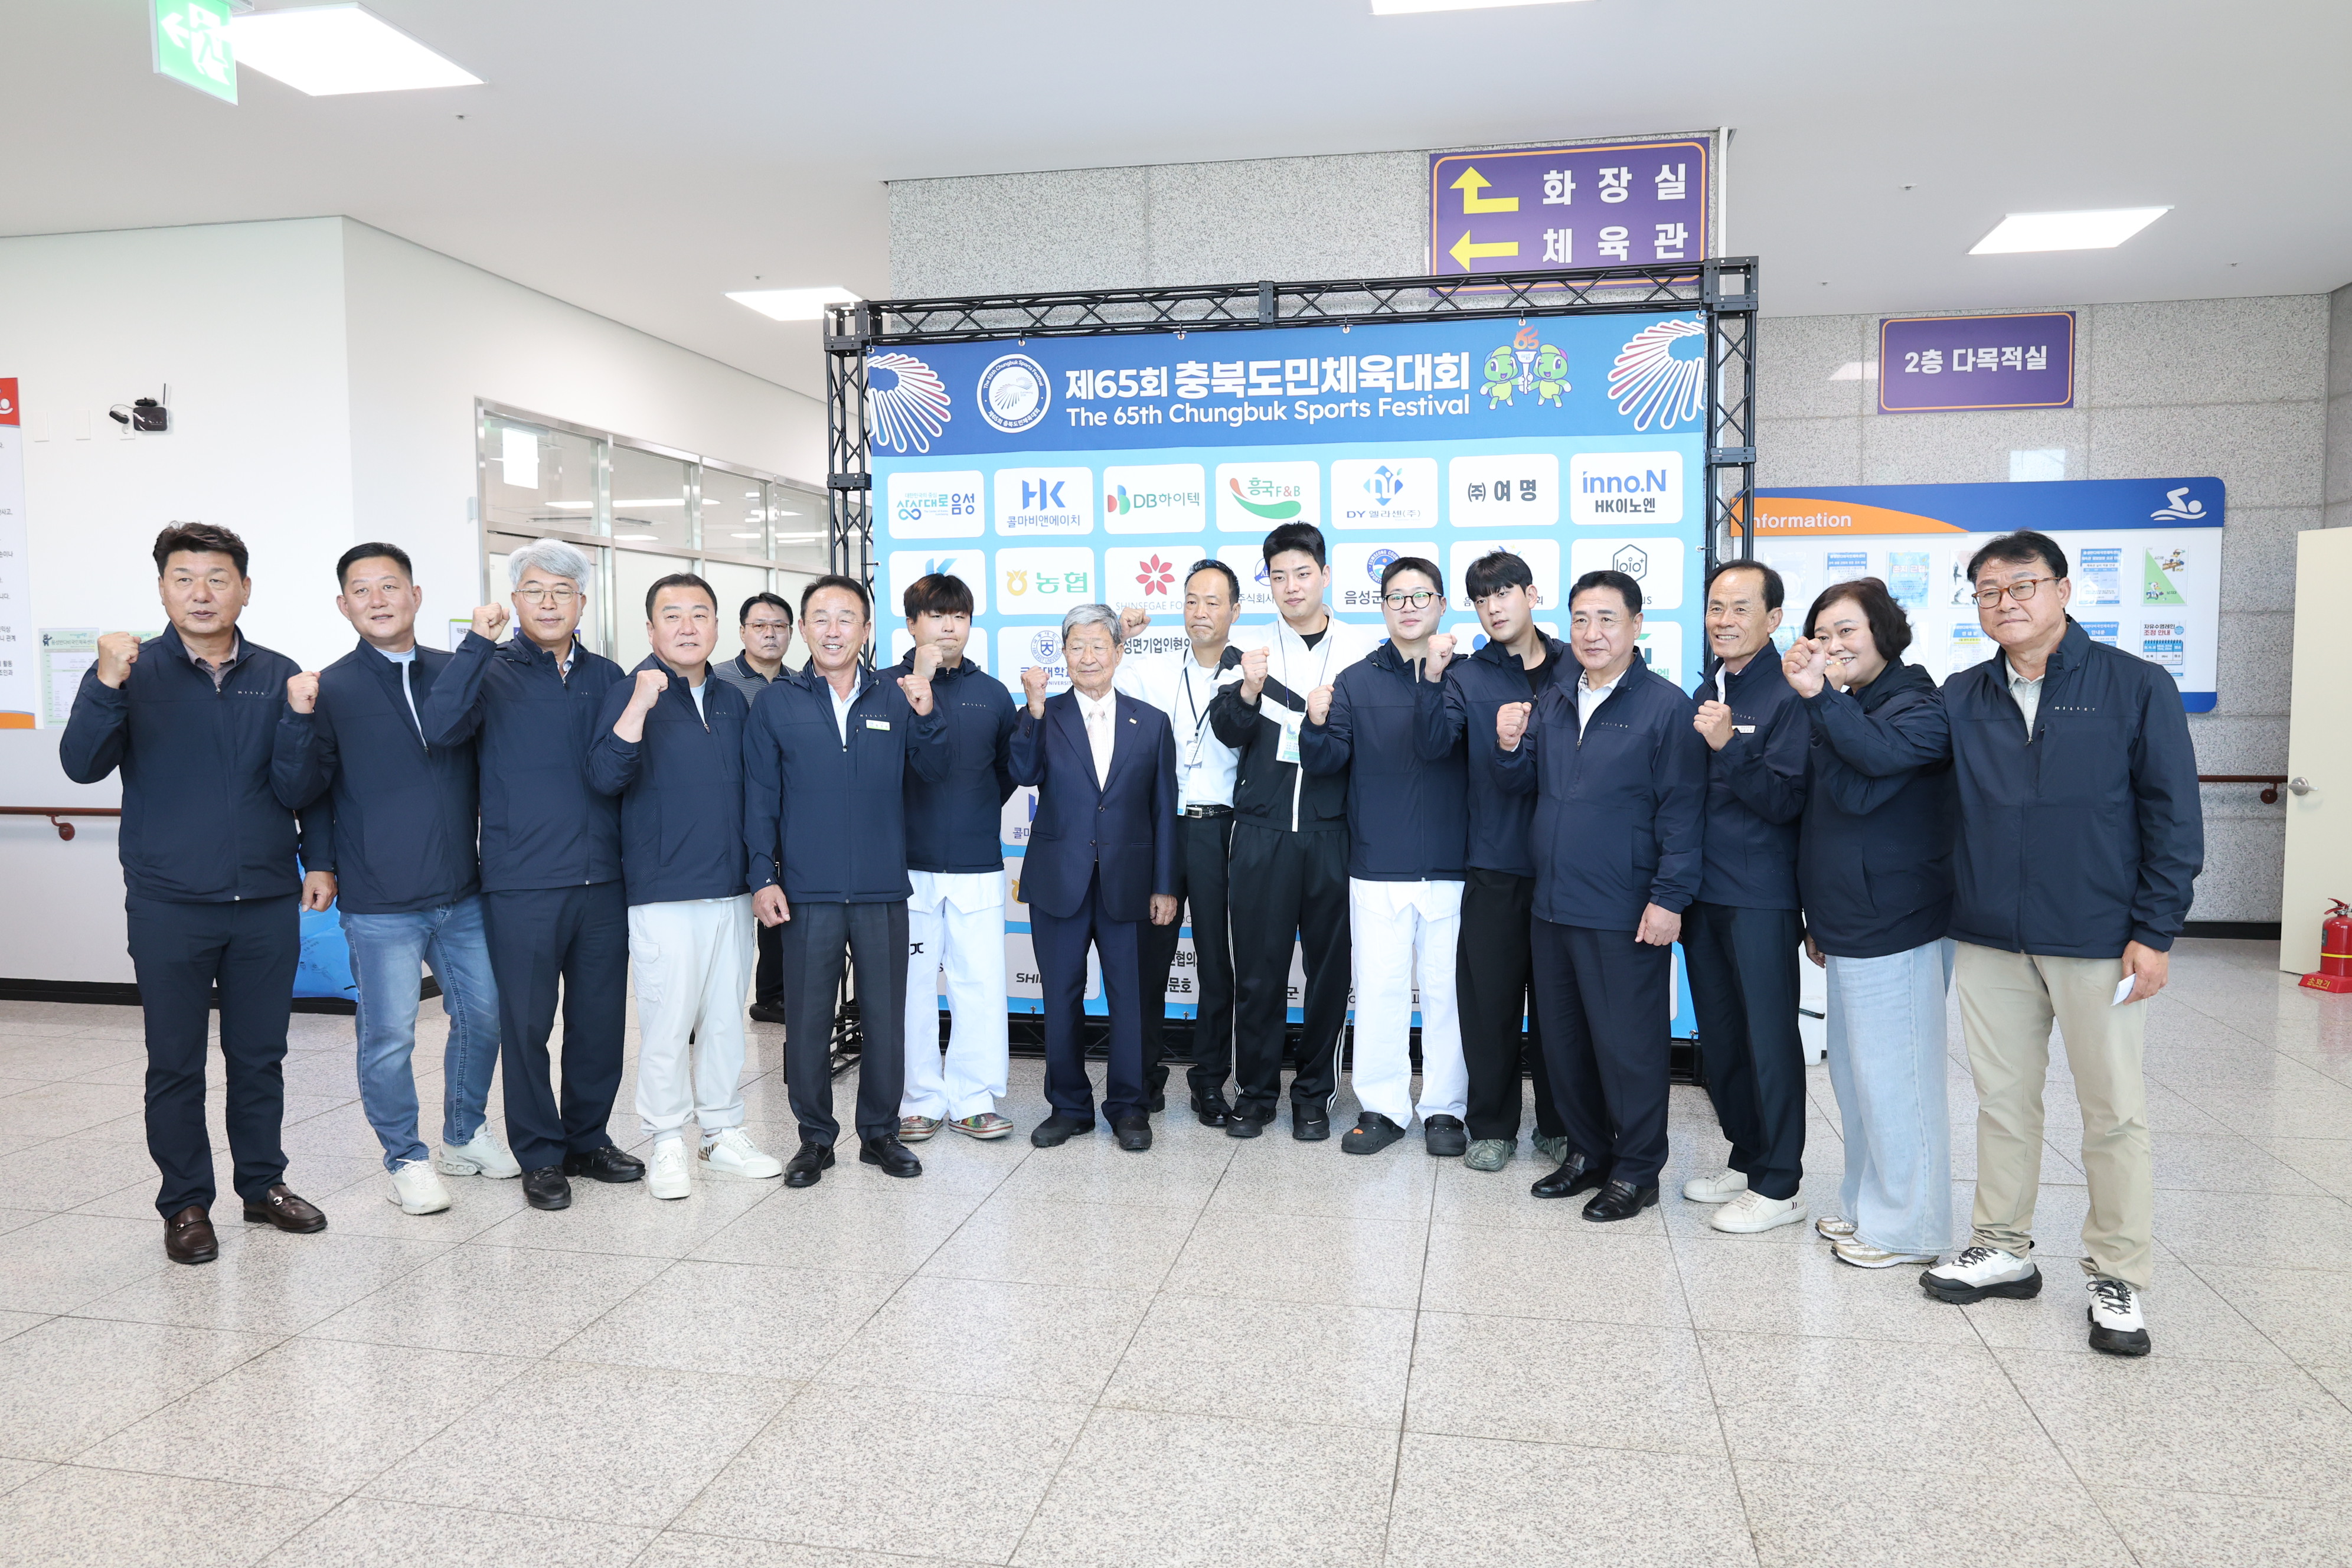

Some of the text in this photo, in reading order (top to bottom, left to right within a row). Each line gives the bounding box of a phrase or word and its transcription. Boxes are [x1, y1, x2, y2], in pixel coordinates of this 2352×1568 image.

[1904, 345, 2047, 374] 2층 다목적실
[995, 360, 1018, 371] Chungbuk
[1018, 360, 1033, 371] Sports
[1031, 368, 1044, 387] Festival
[1065, 351, 1470, 400] 제65회 충북도민체육대회
[1066, 393, 1469, 428] The 65th Chungbuk Sports Festival
[1583, 469, 1667, 494] inno.N
[951, 493, 975, 515] 음성
[1022, 478, 1066, 511] HK
[1133, 492, 1200, 508] DB하이텍
[1346, 510, 1366, 518] DY
[1595, 497, 1656, 514] HK이노엔
[1007, 514, 1080, 528] 콜마비앤에이치
[1753, 512, 1851, 529] nformation
[1368, 549, 1387, 566] EUMSEONG
[1035, 571, 1088, 594] 농협
[1116, 601, 1183, 610] SHINSEGAE FO
[2308, 977, 2331, 987] 소화기
